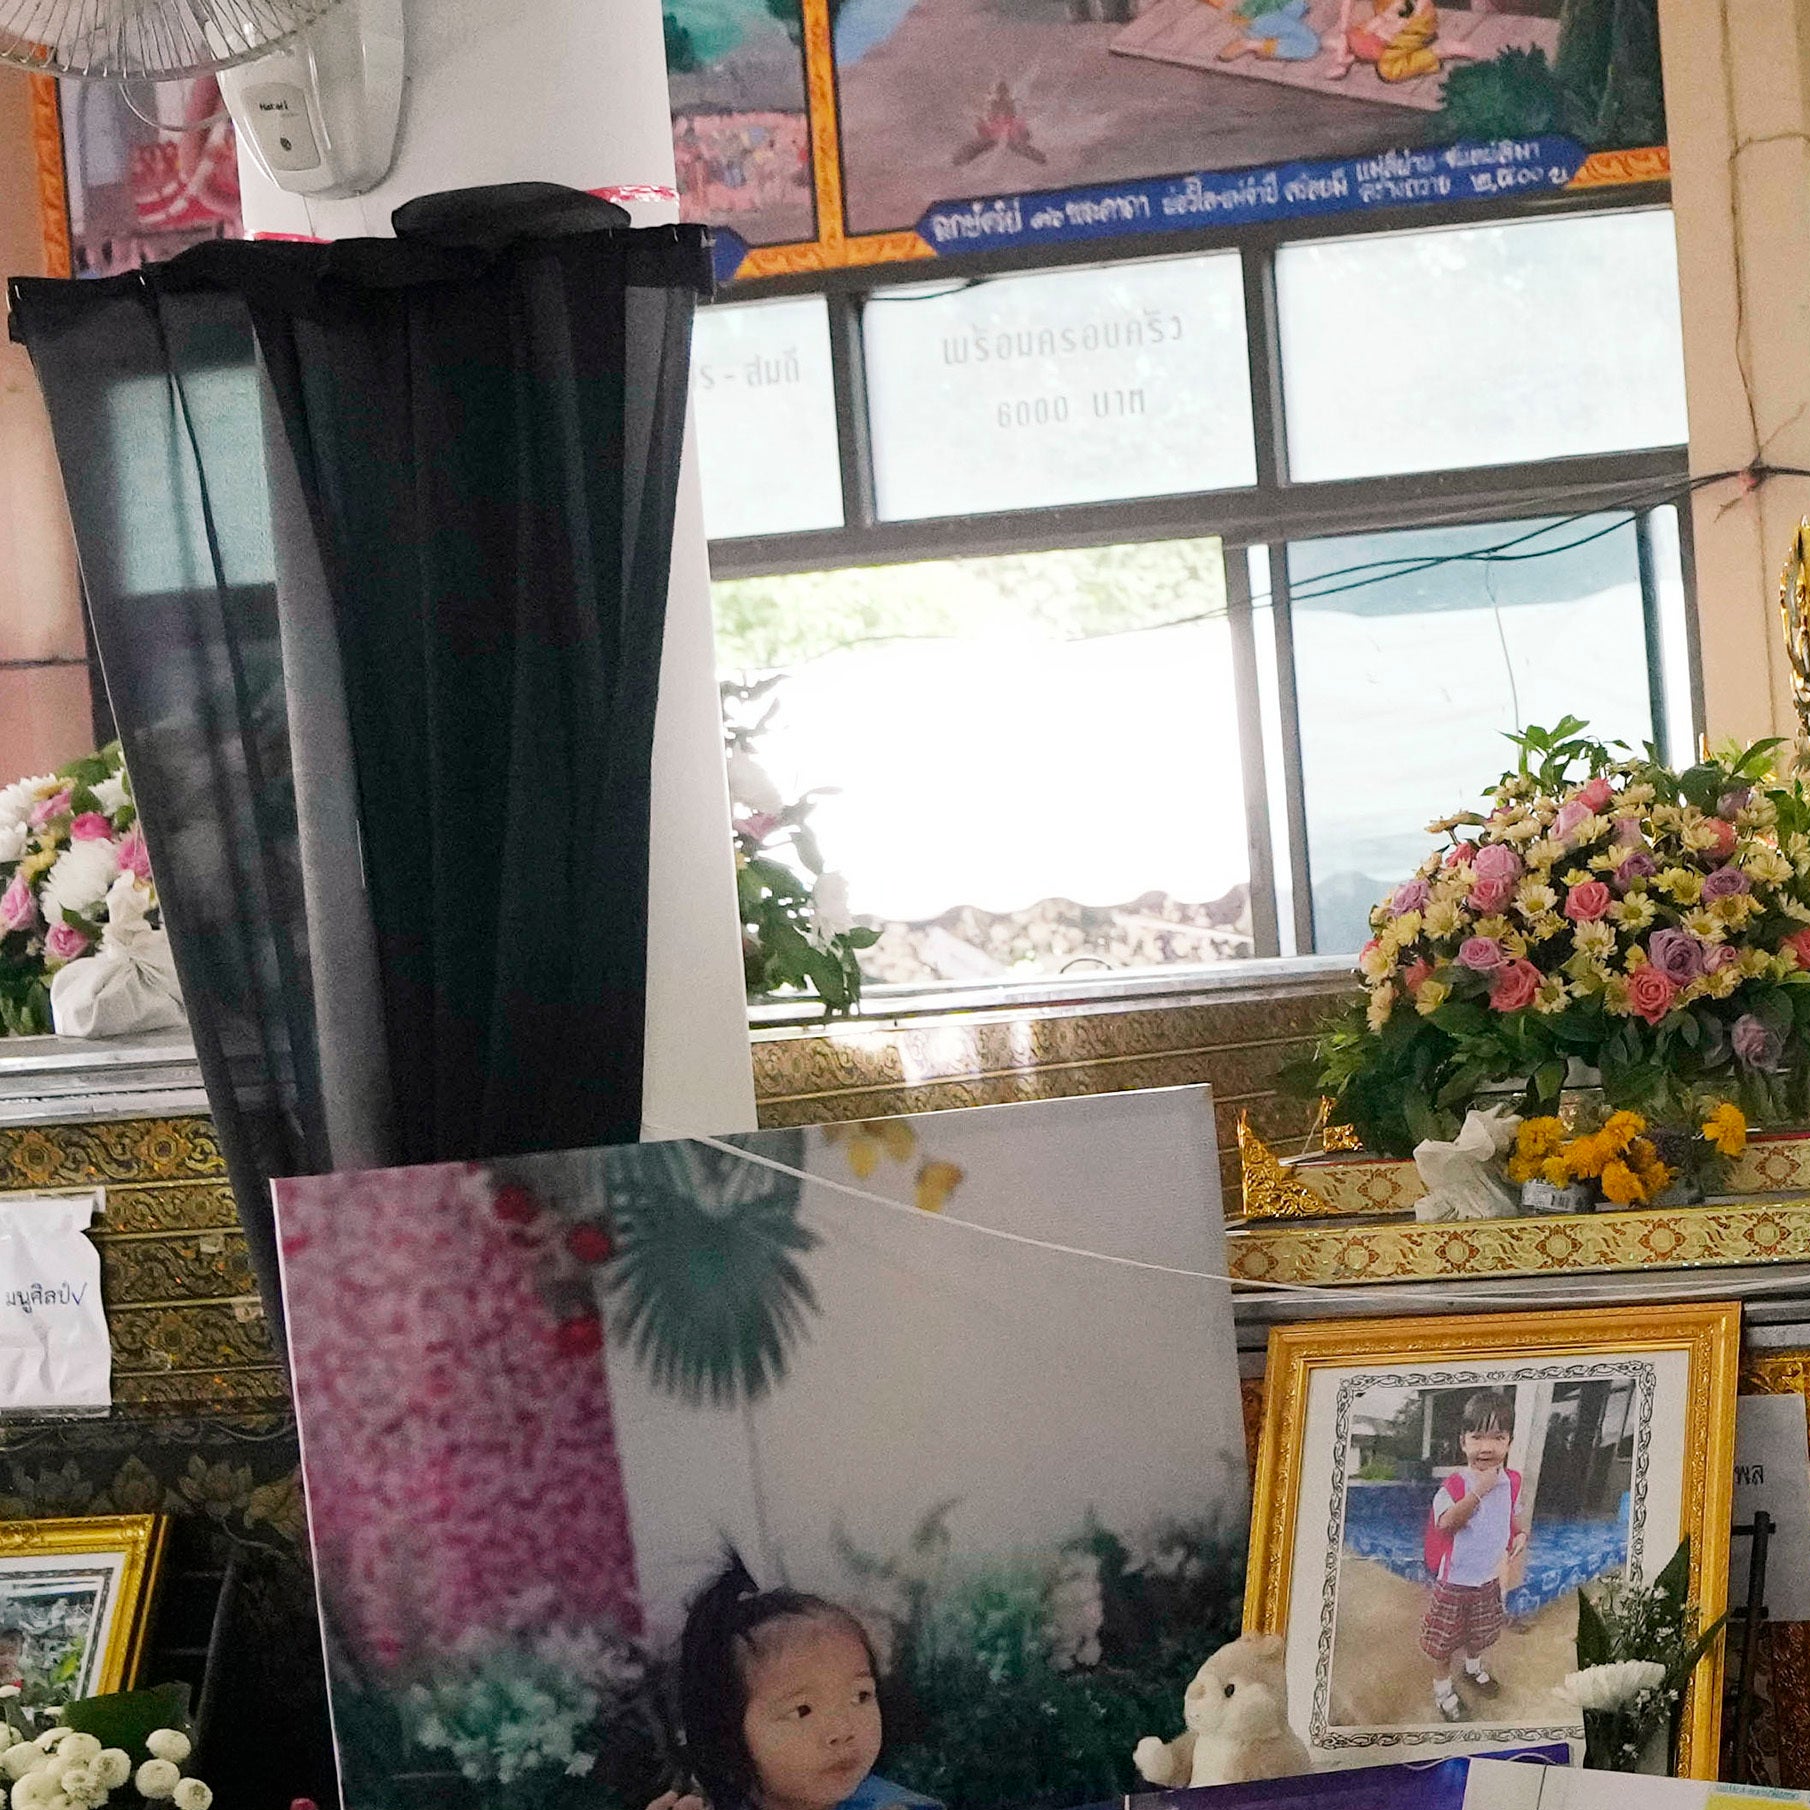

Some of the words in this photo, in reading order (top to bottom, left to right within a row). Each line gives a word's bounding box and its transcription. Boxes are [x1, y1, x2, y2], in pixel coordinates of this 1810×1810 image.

[942, 311, 1185, 366] พร้อมครอบครัว
[997, 396, 1070, 430] 6000
[1093, 387, 1147, 420] บาท
